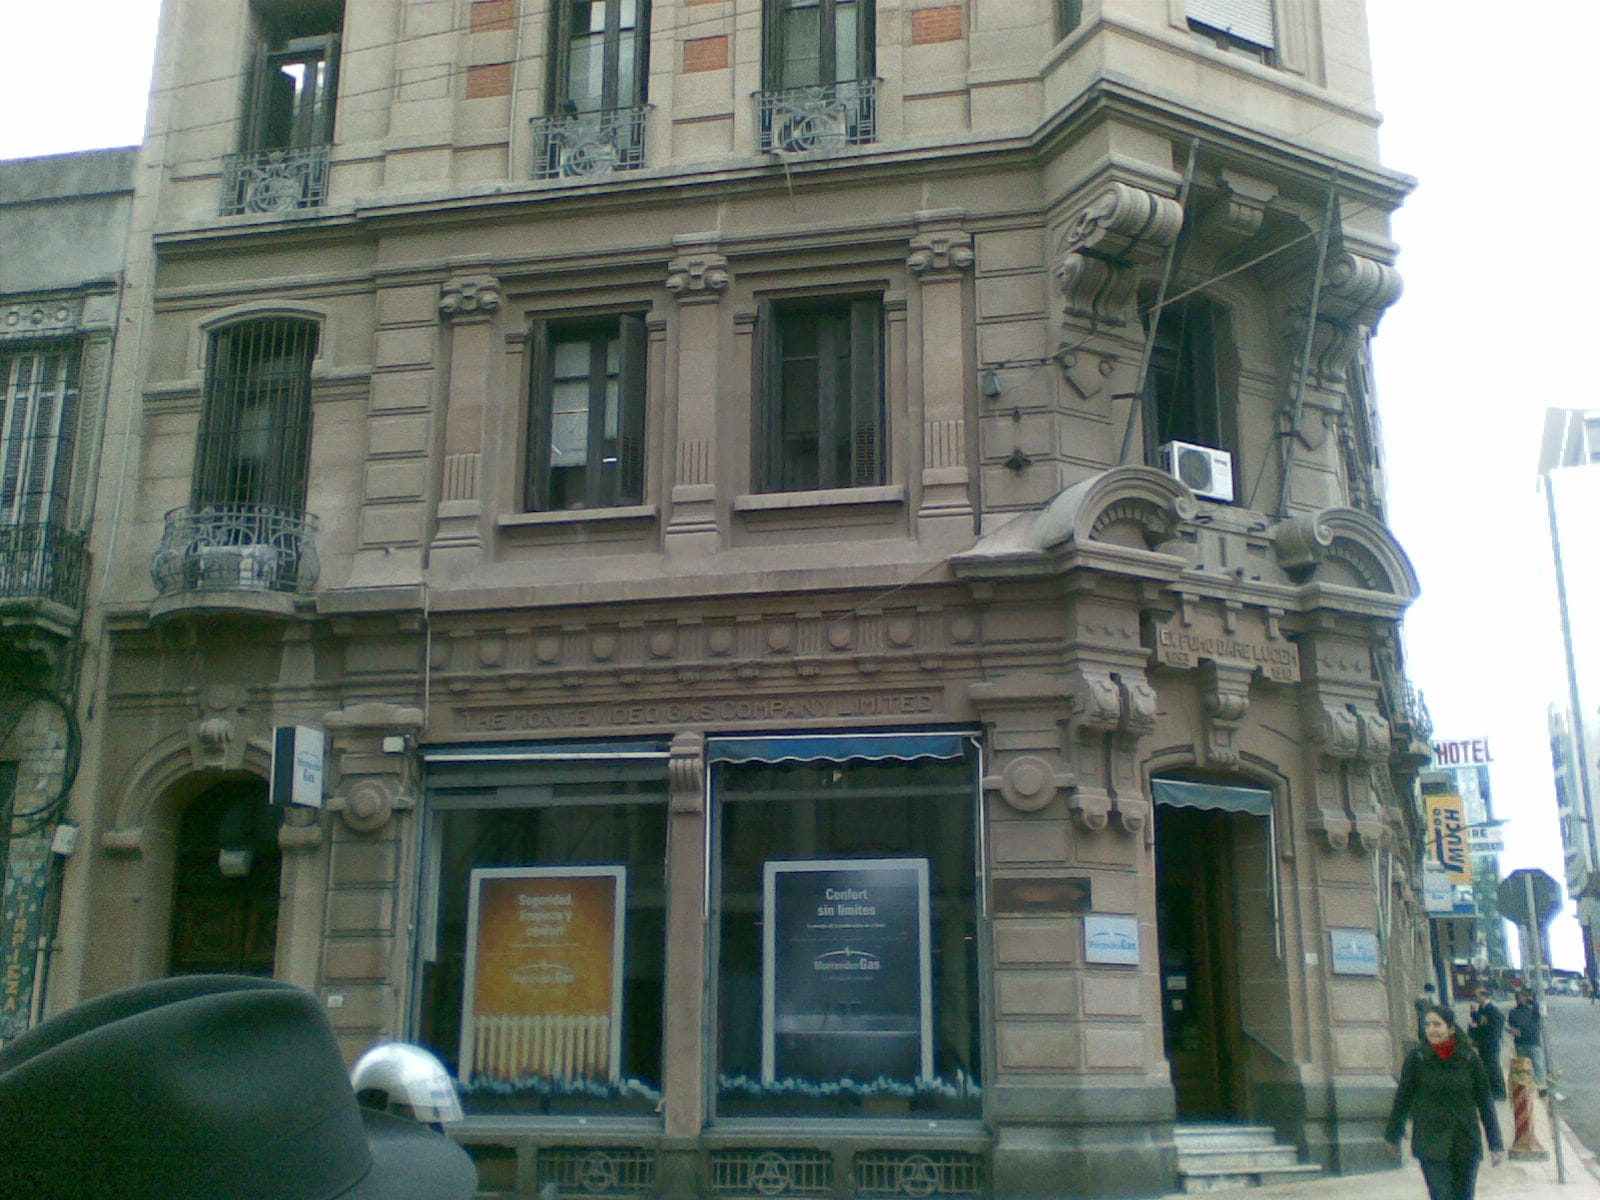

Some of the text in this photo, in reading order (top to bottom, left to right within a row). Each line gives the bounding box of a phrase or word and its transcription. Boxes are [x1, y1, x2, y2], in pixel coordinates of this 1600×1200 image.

[667, 700, 715, 723] GAS
[719, 698, 827, 721] COMPANY
[838, 694, 932, 717] LIMITED
[1435, 736, 1494, 766] HOTEL
[825, 888, 868, 900] Confort
[817, 905, 835, 917] sin
